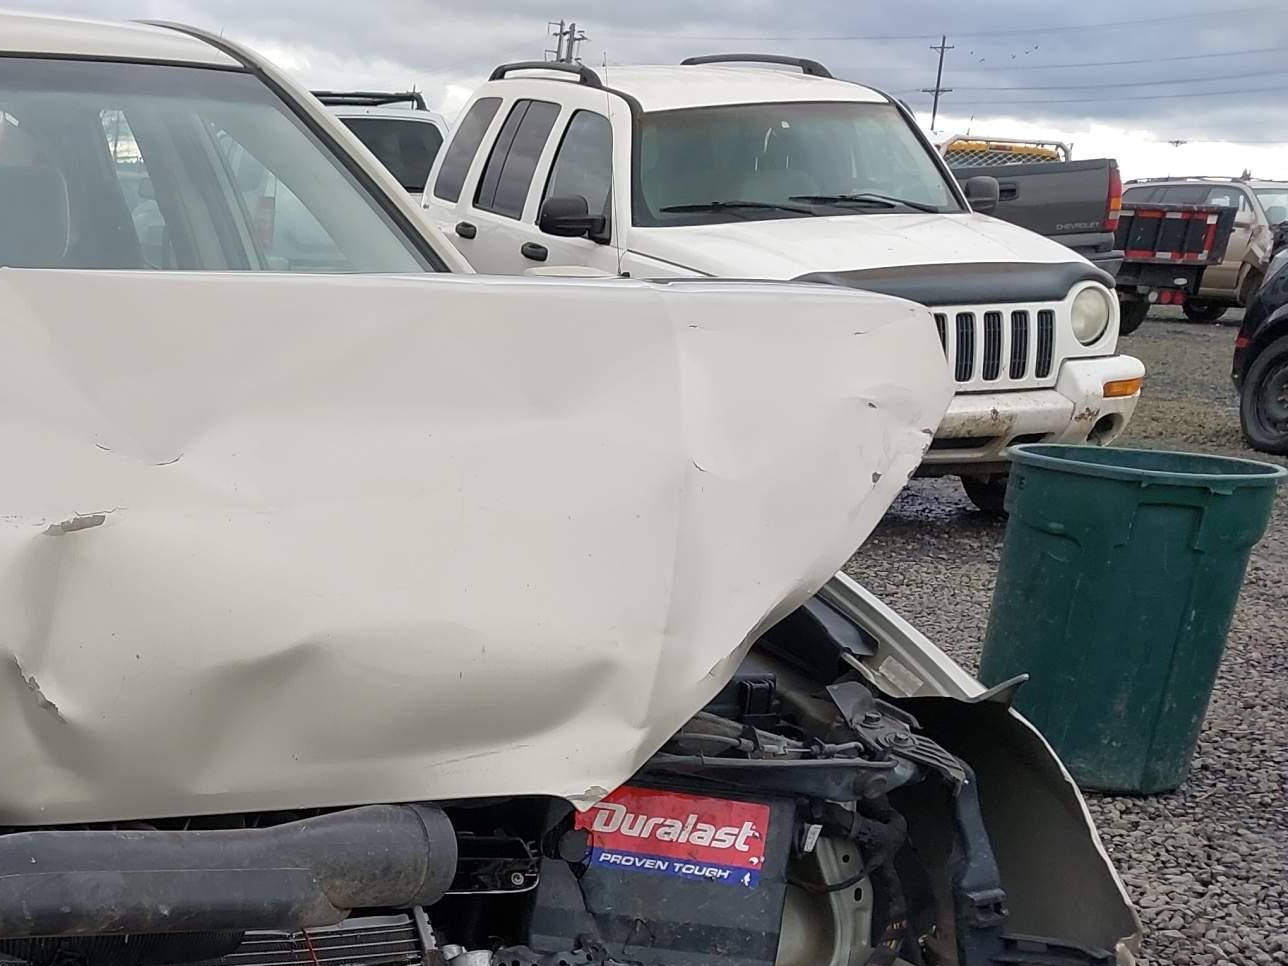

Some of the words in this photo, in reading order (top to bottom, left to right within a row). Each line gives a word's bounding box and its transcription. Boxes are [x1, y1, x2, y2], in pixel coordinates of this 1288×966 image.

[591, 802, 760, 852] Duralast
[599, 852, 669, 870] PROVEN
[673, 863, 730, 879] TOUGH
